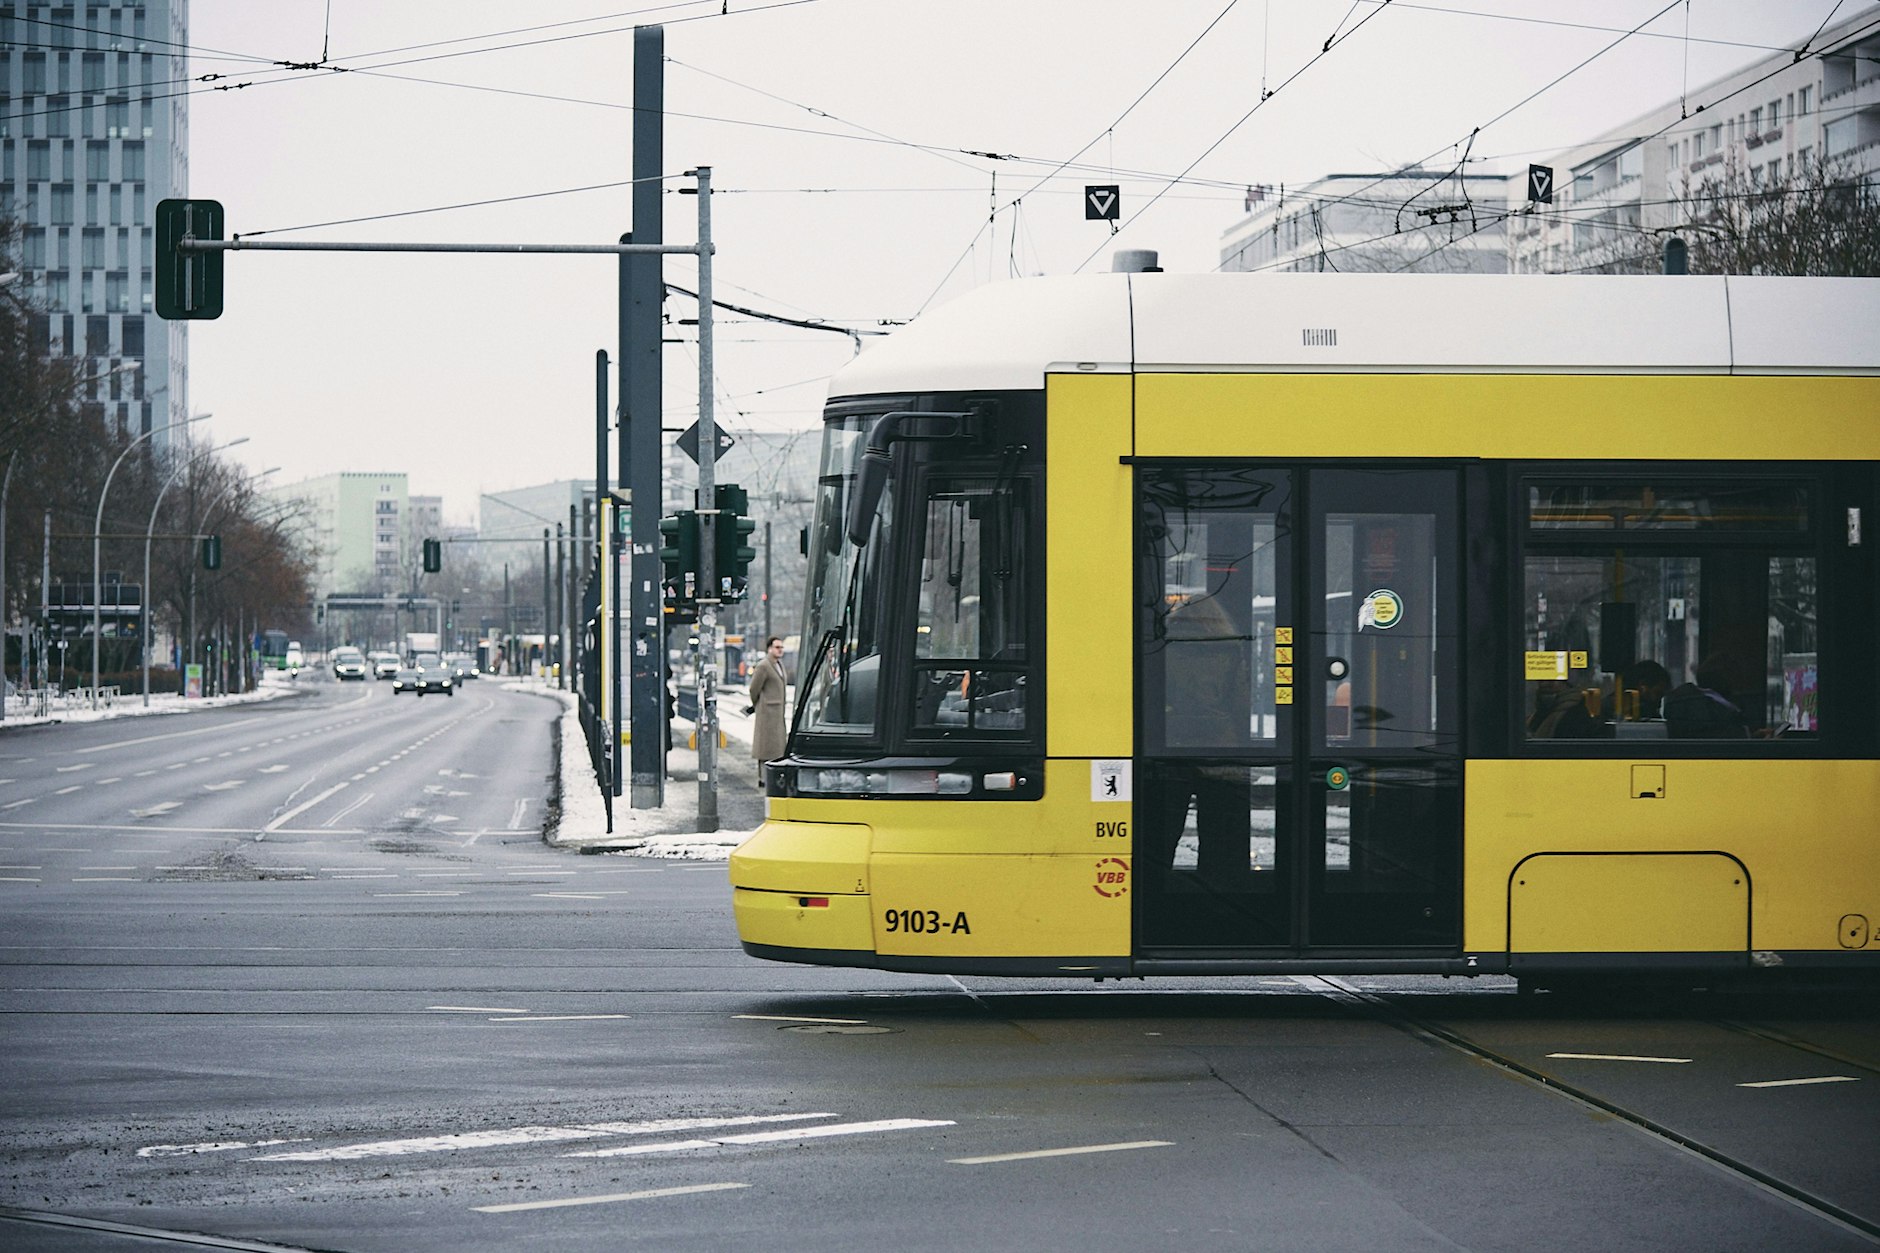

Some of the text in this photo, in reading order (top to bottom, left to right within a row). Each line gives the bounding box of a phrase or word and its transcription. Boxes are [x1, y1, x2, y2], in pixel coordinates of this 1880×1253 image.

[1096, 822, 1127, 838] BVG
[1097, 872, 1126, 884] VBB
[885, 909, 971, 935] 9103-A
